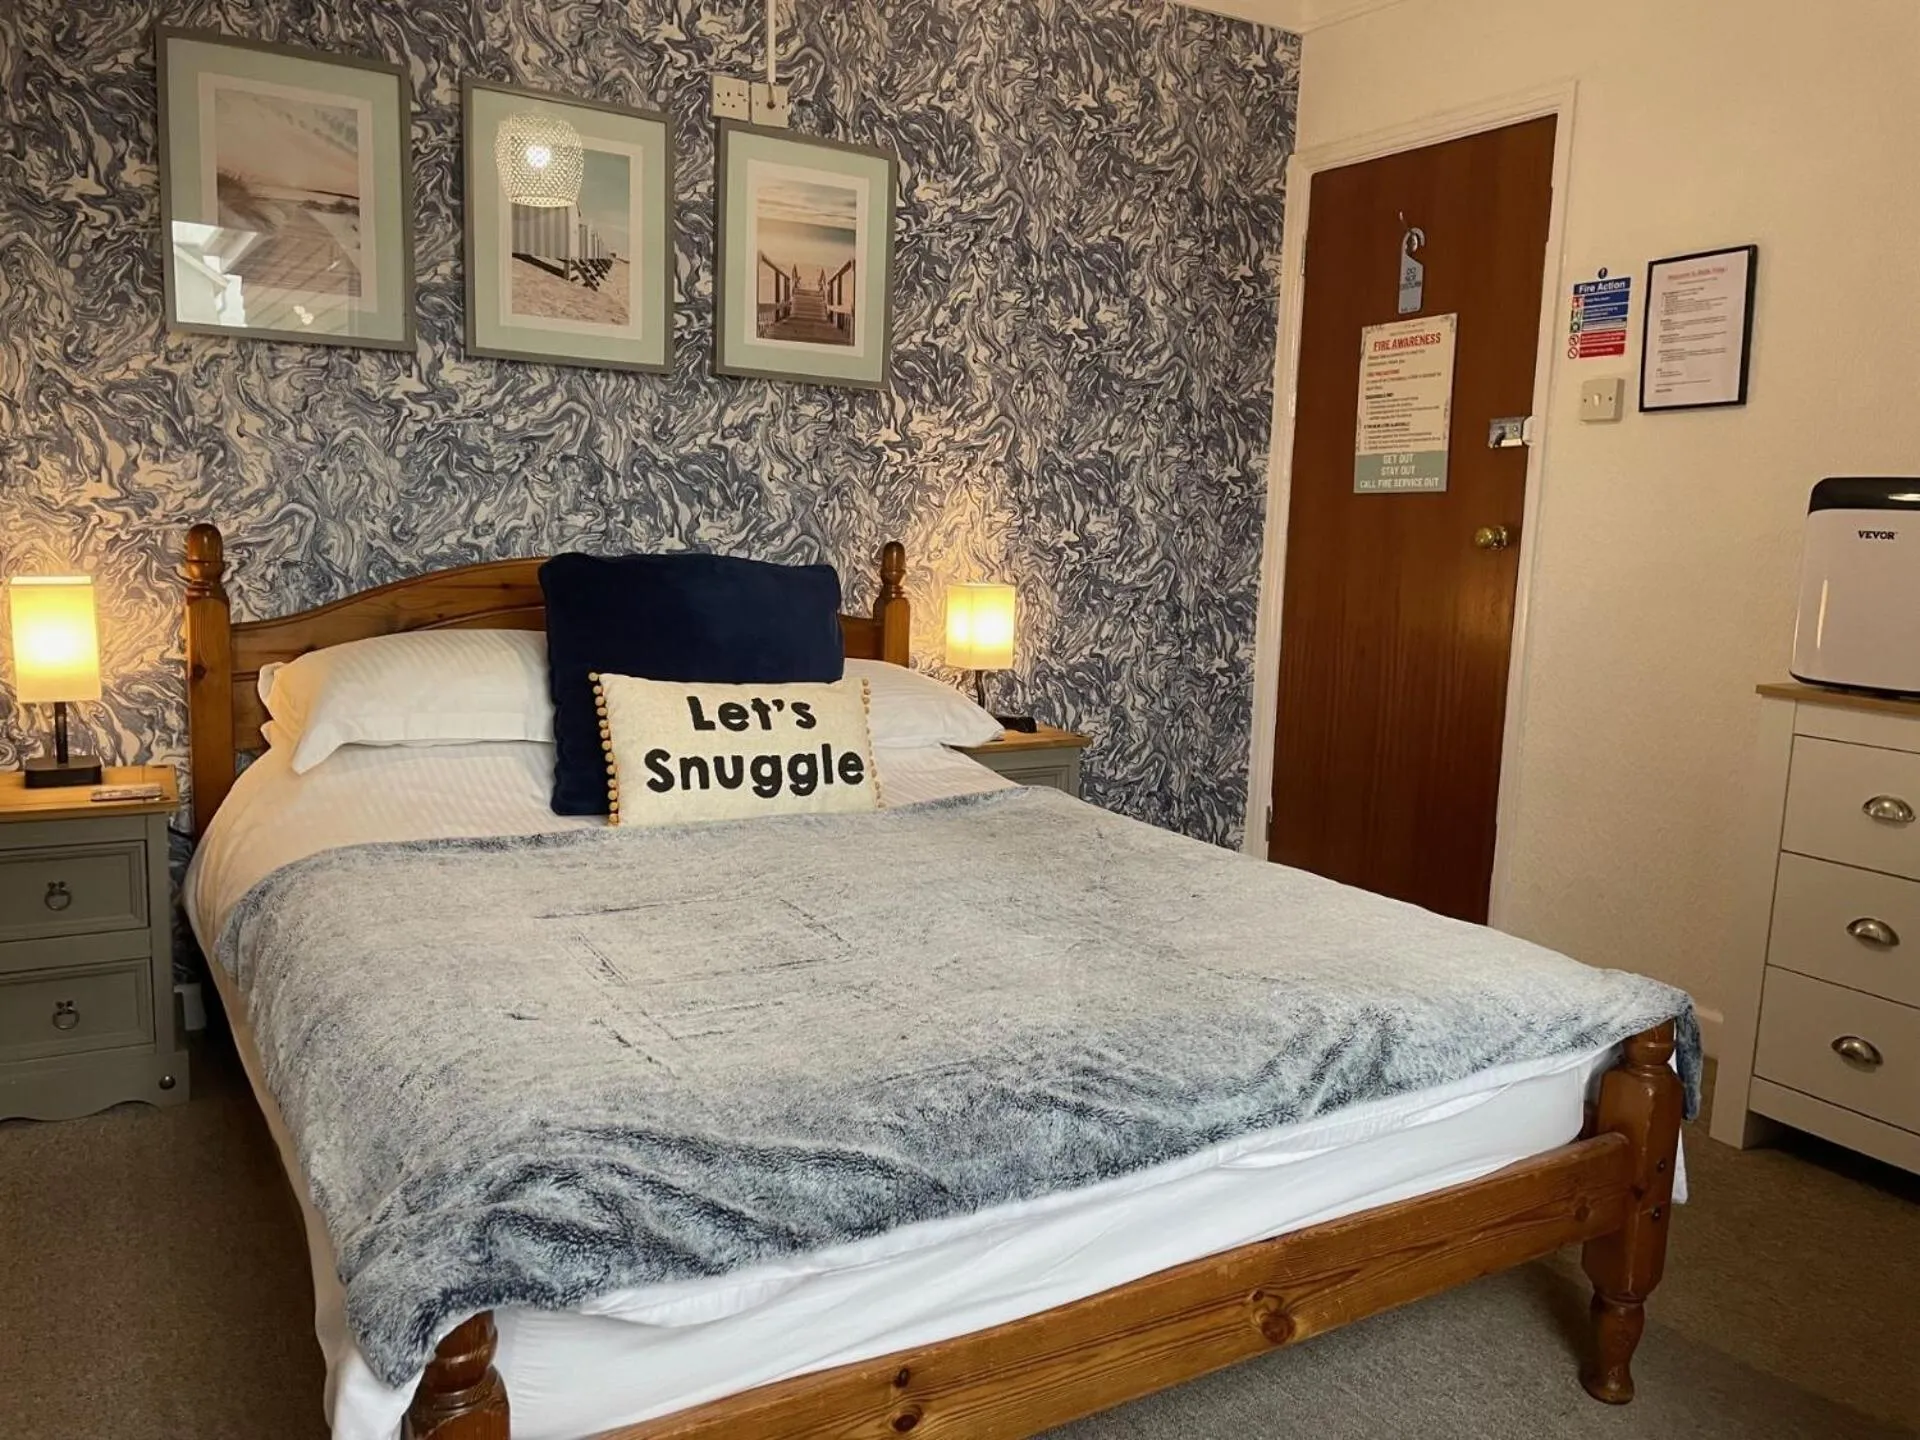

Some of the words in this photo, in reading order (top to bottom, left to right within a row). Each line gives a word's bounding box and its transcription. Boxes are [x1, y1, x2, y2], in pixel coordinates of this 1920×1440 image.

[1579, 285, 1595, 294] Fire
[1597, 281, 1626, 291] Action
[1374, 340, 1391, 352] FIRE
[1392, 332, 1441, 350] AWARENESS
[1383, 454, 1397, 464] GET
[1399, 453, 1414, 463] OUT
[1381, 466, 1399, 476] STAY
[1401, 465, 1415, 475] OUT
[1360, 480, 1376, 489] CALL
[1378, 479, 1392, 488] FIRE
[1393, 478, 1422, 488] SERVICE
[1424, 477, 1439, 487] OUT
[1858, 530, 1895, 540] VEVOR
[686, 695, 817, 732] Let's
[644, 743, 865, 799] Snuggle
